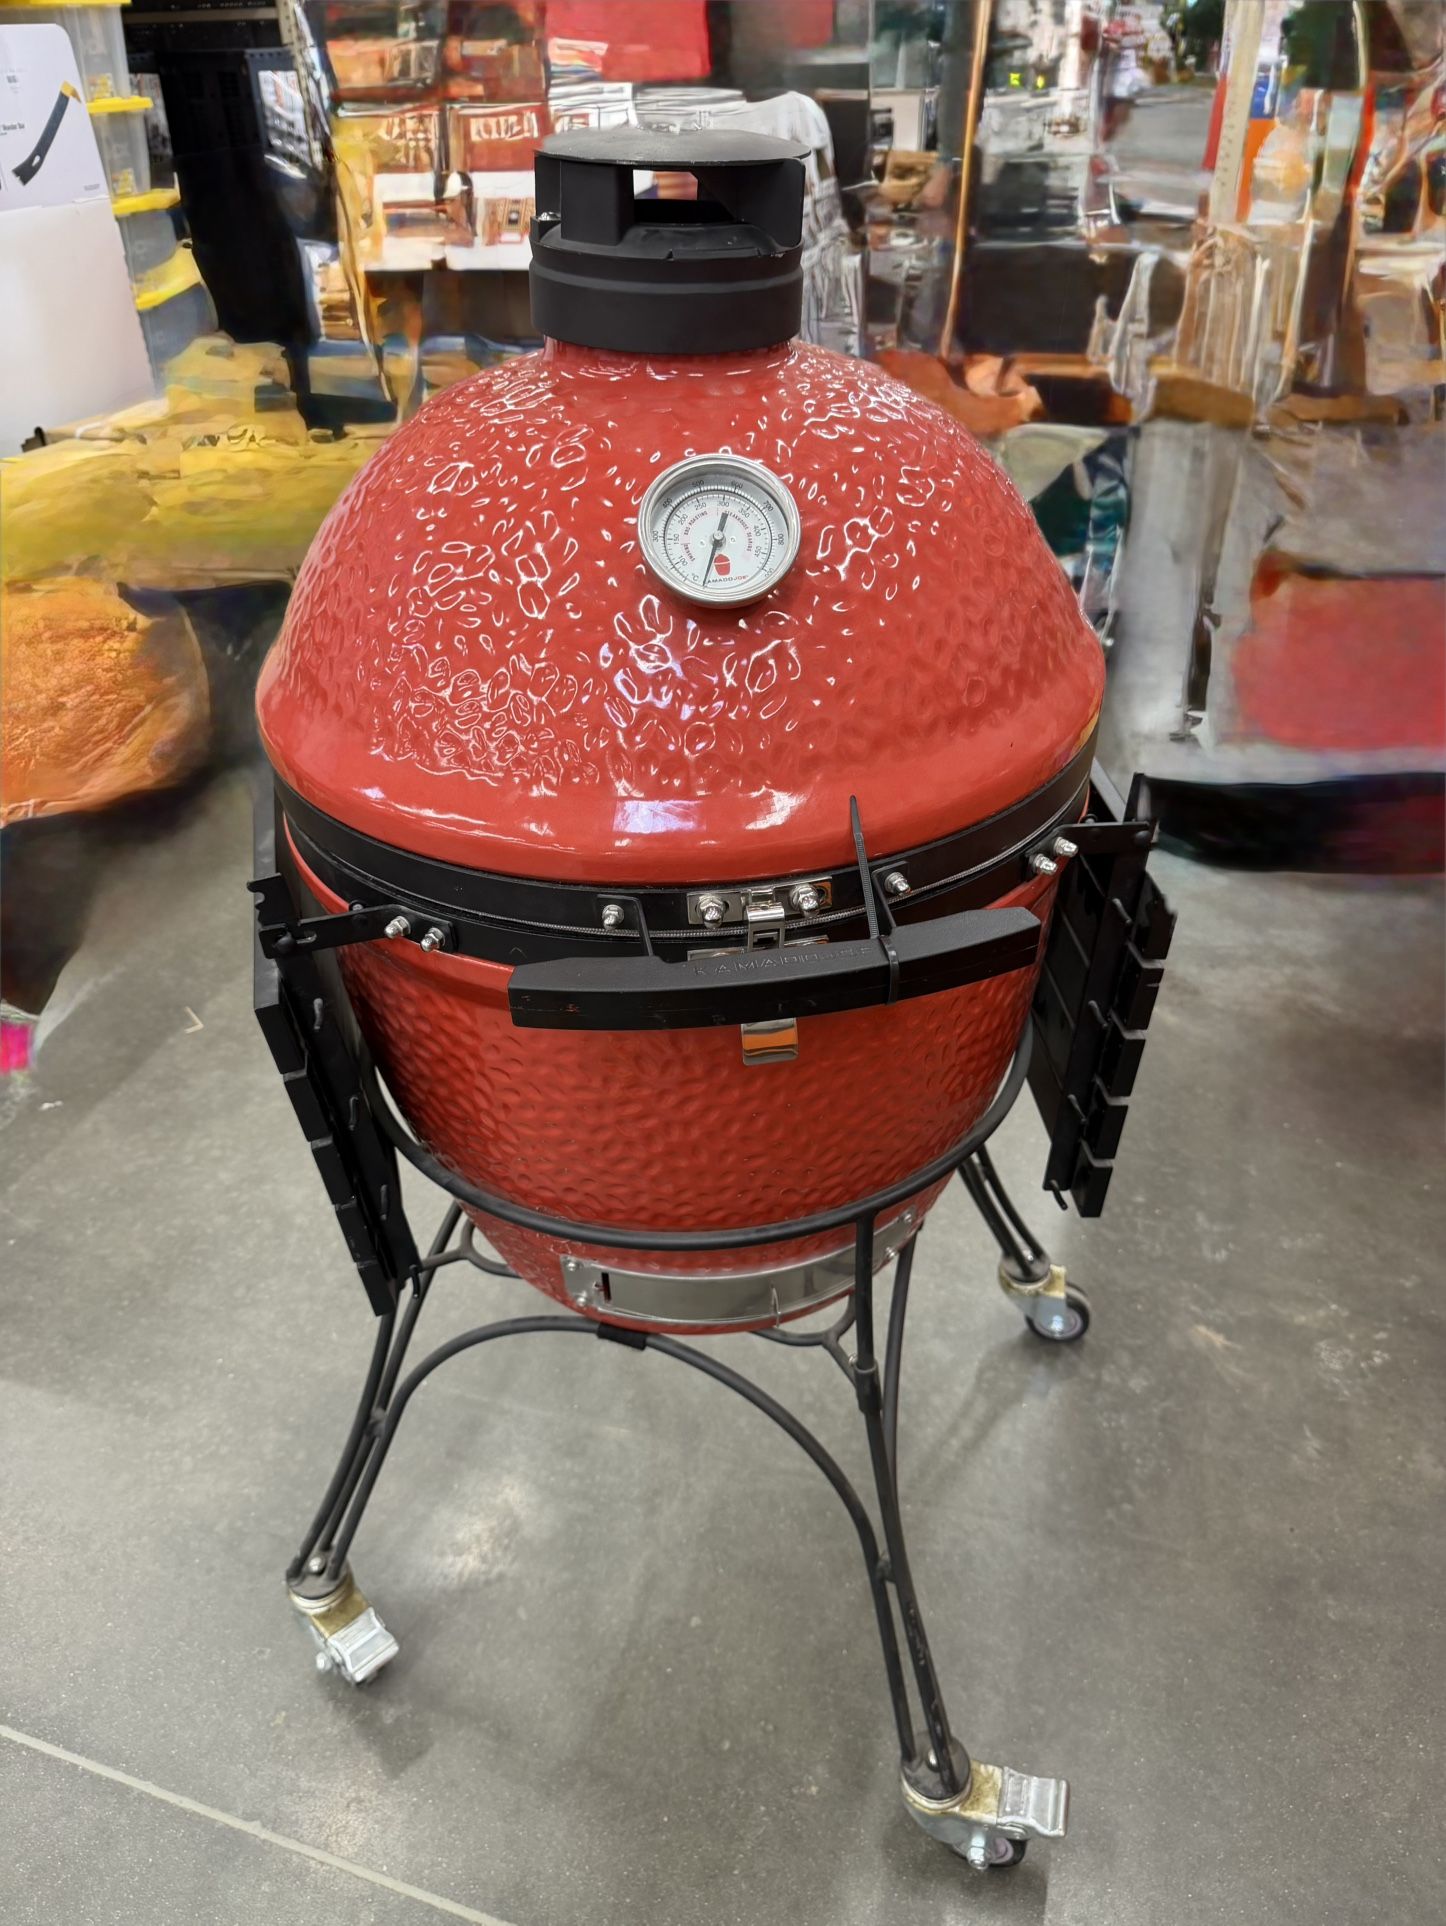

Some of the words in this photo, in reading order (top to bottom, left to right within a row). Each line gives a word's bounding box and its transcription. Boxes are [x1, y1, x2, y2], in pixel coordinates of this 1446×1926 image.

[694, 502, 707, 511] 250
[763, 500, 774, 512] 700
[678, 513, 689, 526] 200
[777, 533, 785, 546] 800
[679, 555, 689, 567] 100
